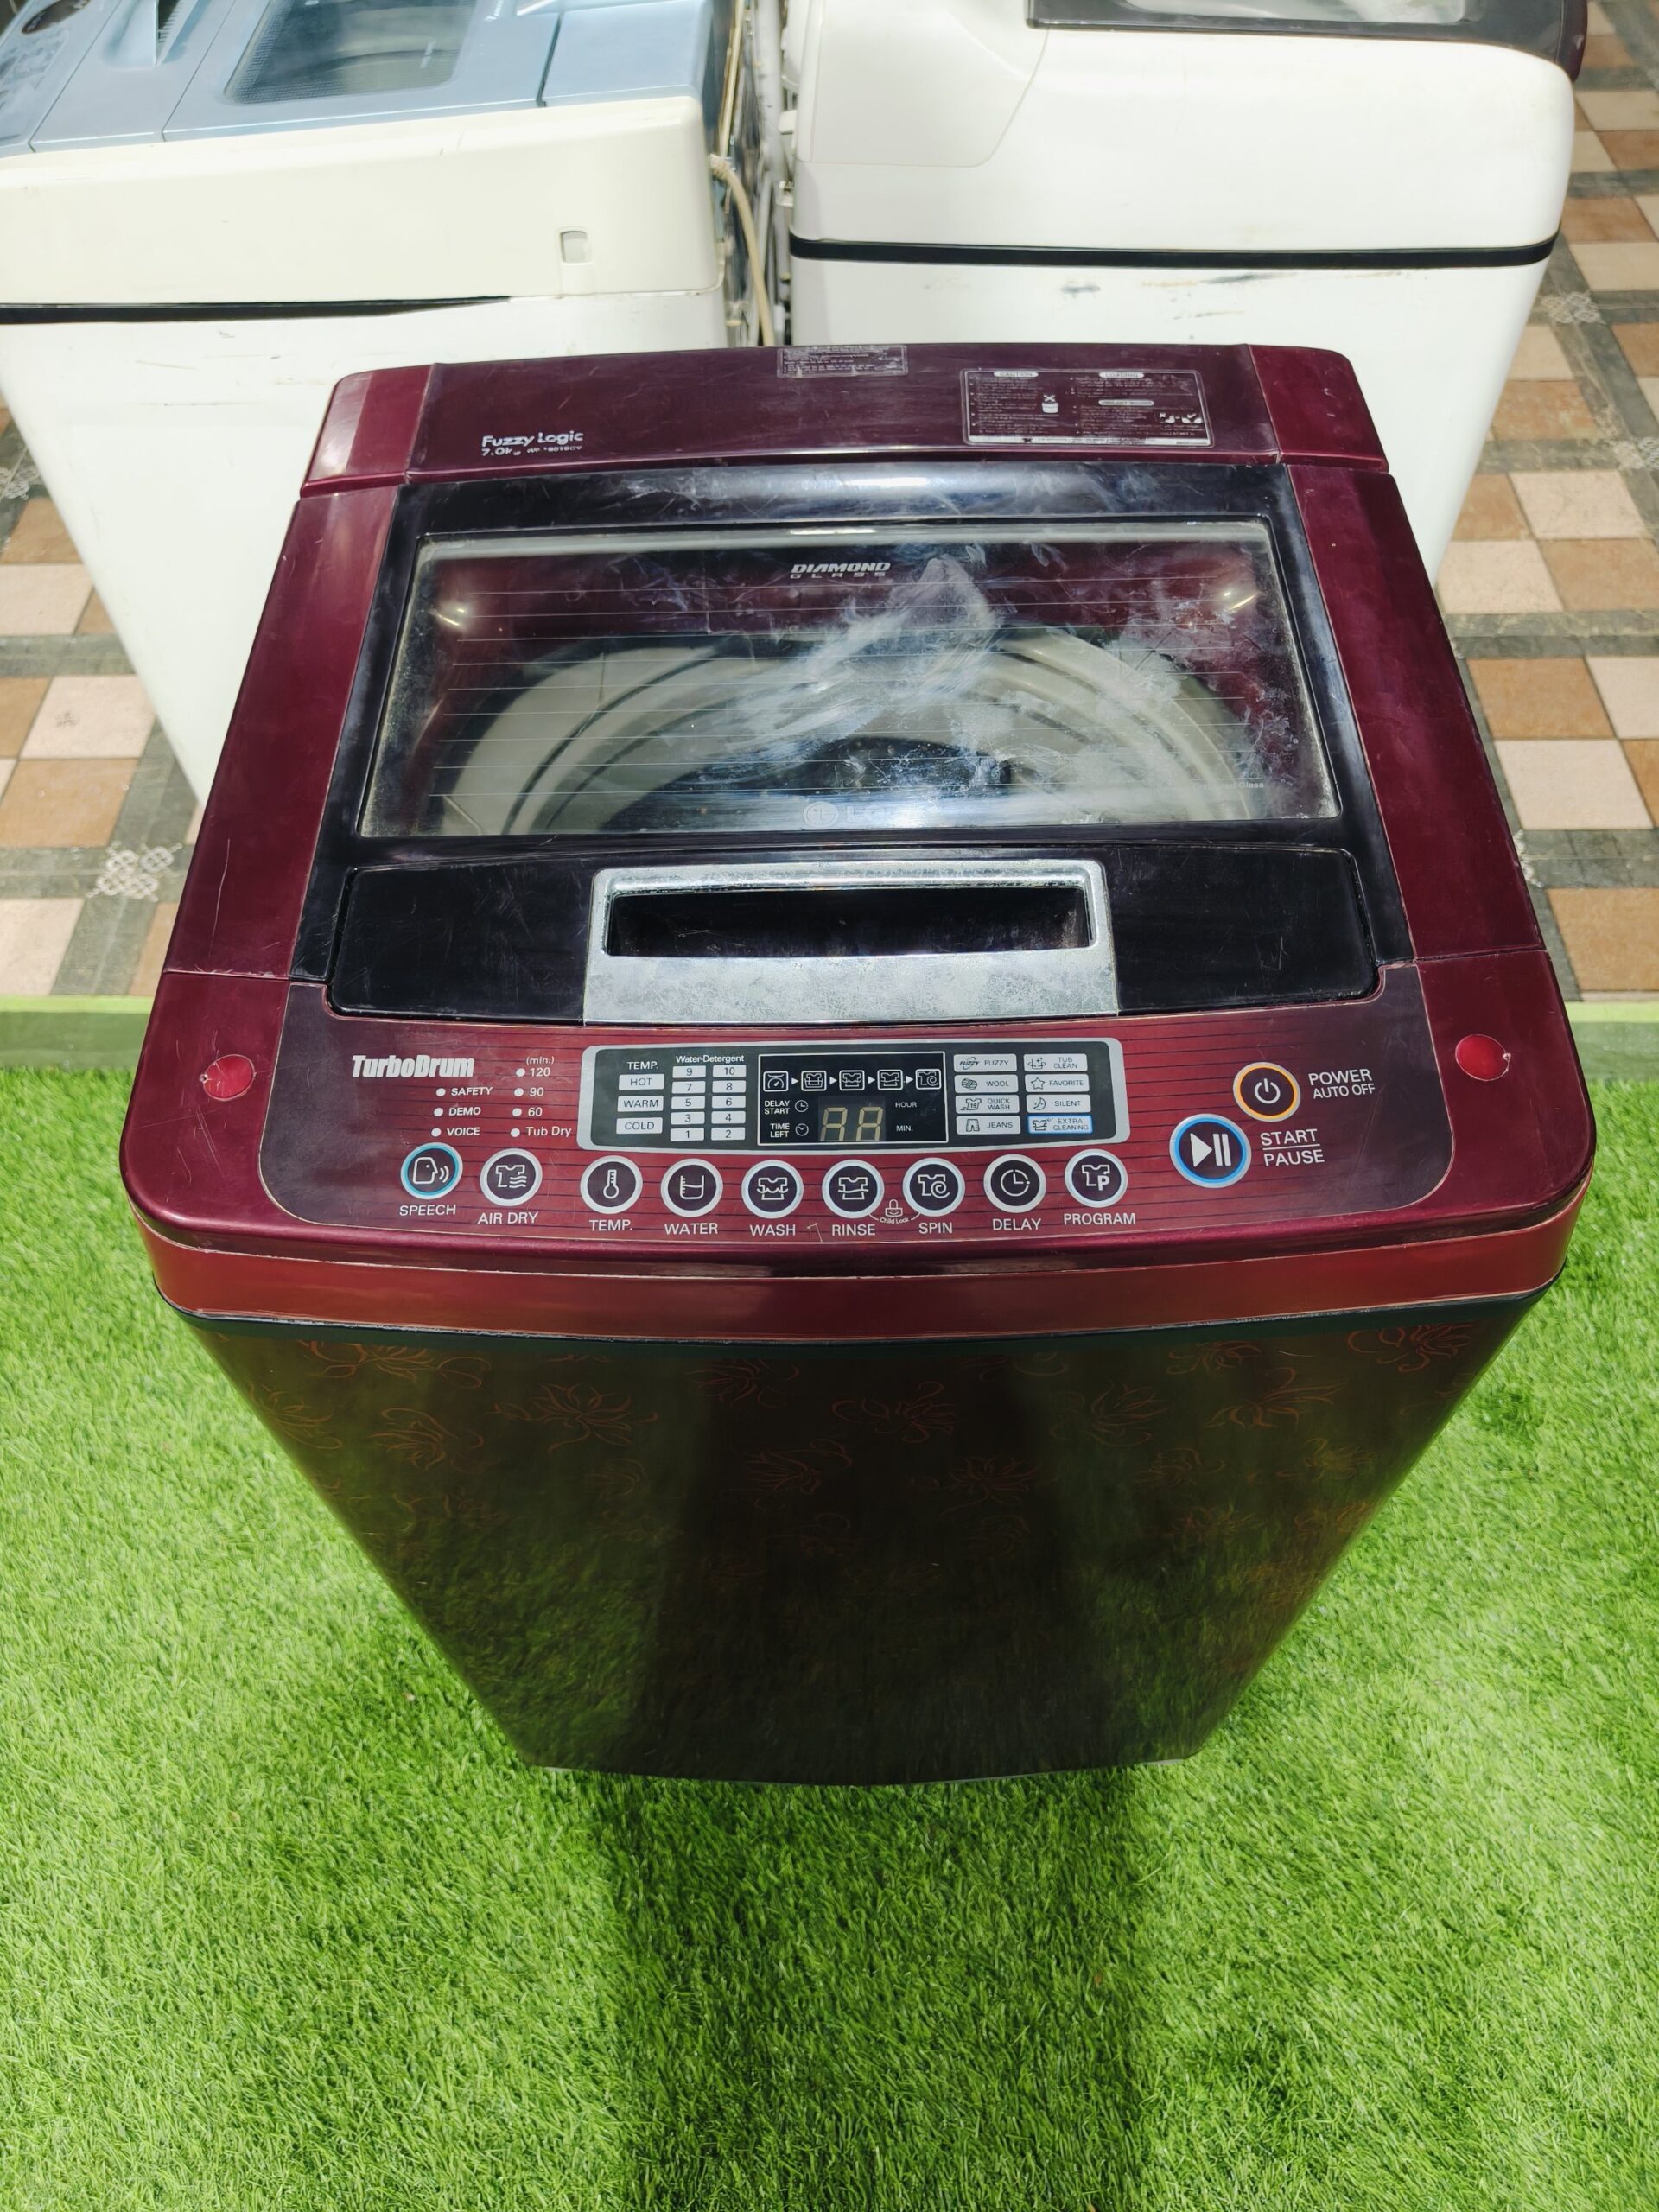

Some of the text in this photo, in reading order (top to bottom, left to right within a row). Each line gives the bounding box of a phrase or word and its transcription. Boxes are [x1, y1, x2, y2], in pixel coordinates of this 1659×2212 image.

[481, 430, 584, 447] Fuzzy Logic
[791, 563, 891, 573] DIAMOND
[525, 1056, 555, 1065] (min.)
[676, 1054, 744, 1063] Water-Detergent
[352, 1054, 475, 1078] TurboDrum
[627, 1061, 658, 1070] TEMP.
[530, 1067, 550, 1077] 120
[686, 1067, 693, 1077] 9
[724, 1067, 735, 1076] 10
[630, 1077, 652, 1086] HOT
[1308, 1069, 1372, 1086] POWER
[451, 1087, 493, 1096] SAFETY
[529, 1087, 544, 1096] 90
[686, 1084, 692, 1092] 7
[726, 1083, 733, 1091] 8
[1313, 1083, 1376, 1099] AUTO OFF
[623, 1099, 659, 1108] WARM
[685, 1098, 691, 1107] 5
[726, 1098, 733, 1107] 6
[448, 1107, 481, 1116] DEMO
[528, 1107, 543, 1116] 60
[684, 1114, 691, 1122] 3
[725, 1114, 732, 1122] 4
[624, 1122, 655, 1130] COLD
[447, 1127, 480, 1136] VOICE
[525, 1127, 572, 1137] Tub Dry
[685, 1130, 690, 1139] 1
[725, 1130, 732, 1139] 2
[1260, 1128, 1319, 1146] START
[1263, 1149, 1325, 1166] PAUSE
[399, 1205, 456, 1216] SPEECH
[478, 1212, 538, 1224] AIR DRY
[1064, 1212, 1135, 1225] PROGRAM
[589, 1219, 632, 1231] TEMP.
[918, 1222, 952, 1234] SPIN
[992, 1218, 1041, 1230] DELAY
[664, 1223, 718, 1235] WATER
[749, 1224, 796, 1236] WASH
[831, 1224, 875, 1236] RINSE
